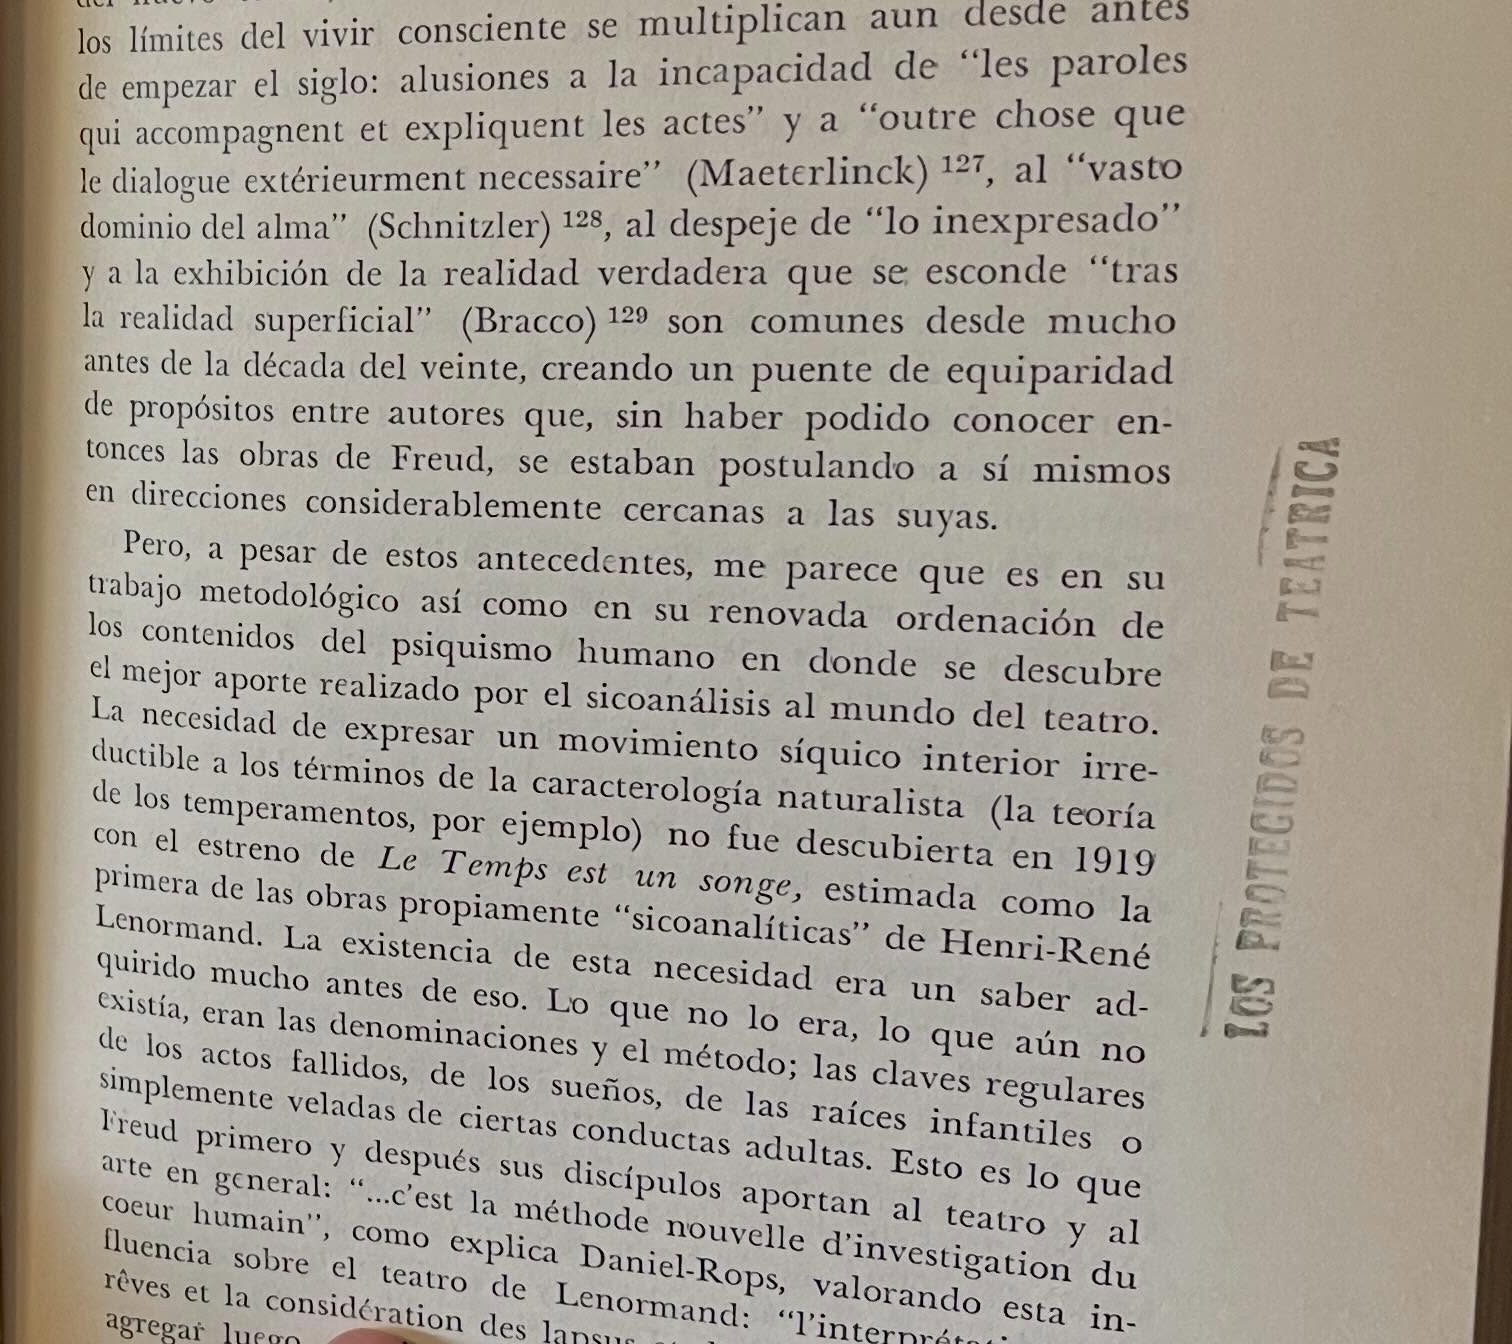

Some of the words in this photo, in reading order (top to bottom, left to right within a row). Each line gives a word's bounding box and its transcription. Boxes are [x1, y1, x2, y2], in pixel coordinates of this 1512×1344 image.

[79, 167, 102, 194] le
[112, 166, 230, 204] dialogue
[244, 164, 466, 194] extérieurment
[687, 154, 928, 198] (Maeterlinck)
[942, 153, 994, 189] 127,
[1015, 153, 1048, 184] al
[123, 528, 191, 562] Pero,
[208, 541, 224, 560] a
[239, 543, 317, 571] pesar
[332, 538, 368, 566] de
[385, 546, 458, 569] estos
[477, 545, 693, 581] antecedentes,
[713, 558, 767, 579] me
[785, 560, 898, 591] parece
[919, 564, 985, 595] que
[1006, 567, 1039, 588] es
[1061, 569, 1103, 590] en
[1127, 570, 1165, 591] su
[1275, 437, 1341, 622] TEATRICA
[1267, 647, 1314, 699] DE
[93, 827, 138, 848] con
[155, 827, 179, 854] el
[198, 838, 300, 864] estreno
[320, 840, 355, 868] de
[377, 845, 417, 872] Le
[440, 849, 548, 889] Temps
[567, 862, 608, 885] est
[635, 869, 677, 889] un
[698, 874, 802, 906] songe,
[824, 877, 977, 911] estimada
[1001, 895, 1095, 920] como
[1119, 894, 1153, 924] la
[1224, 973, 1275, 1039] LOS
[104, 1268, 171, 1299] rêves
[184, 1284, 210, 1304] et
[224, 1282, 251, 1309] la
[265, 1294, 464, 1334] considération
[480, 1312, 527, 1341] des
